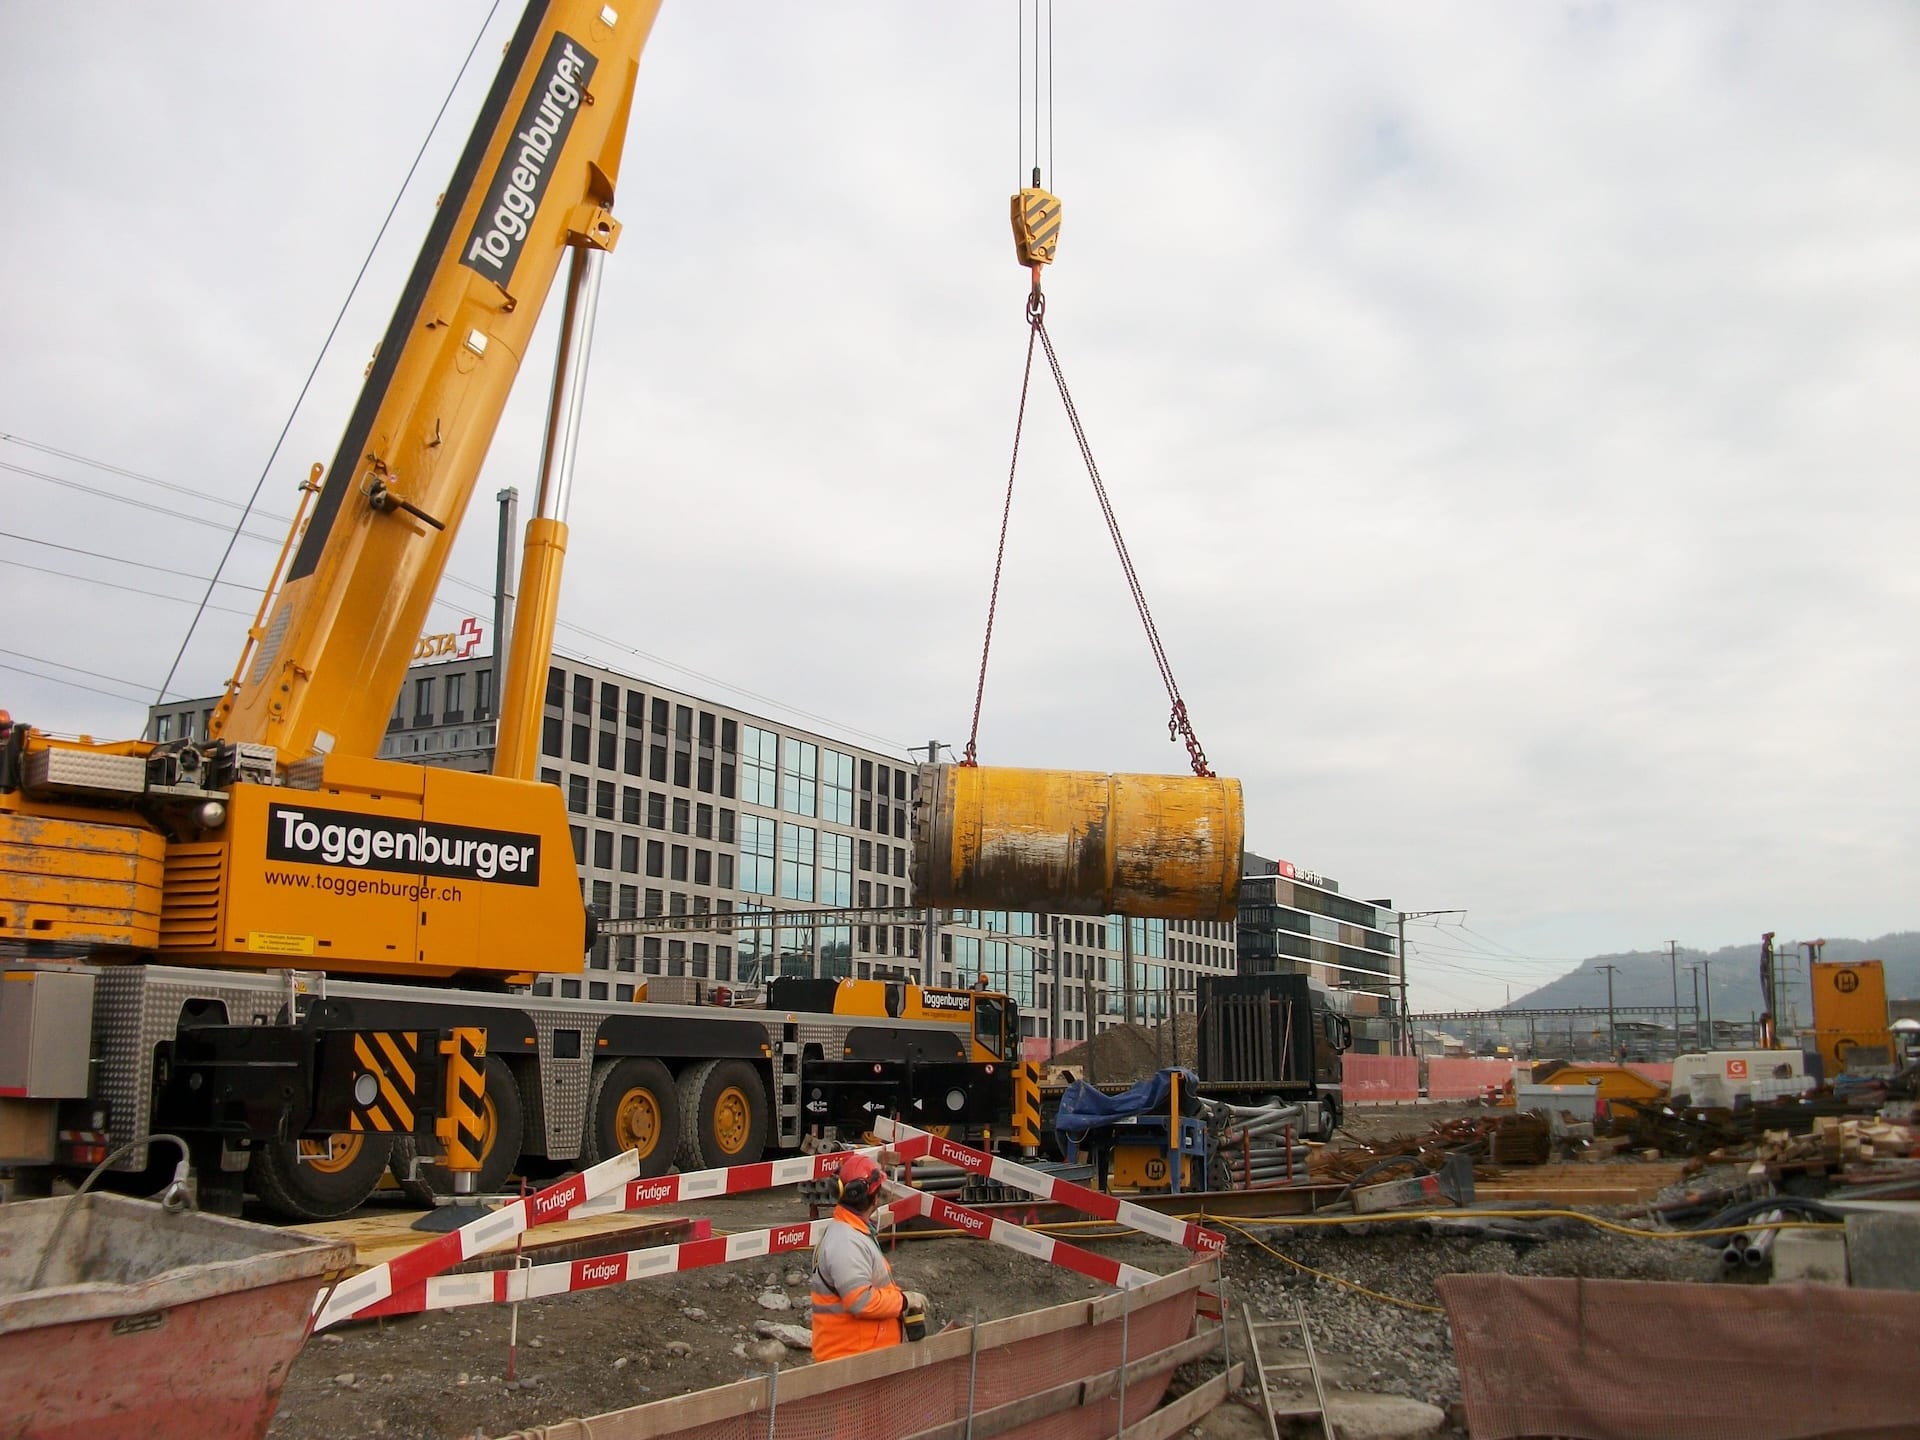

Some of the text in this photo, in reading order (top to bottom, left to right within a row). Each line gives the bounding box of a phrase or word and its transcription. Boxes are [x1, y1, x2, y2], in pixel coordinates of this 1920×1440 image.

[468, 42, 585, 270] Toggenburger
[276, 810, 534, 878] Toggenburger
[265, 869, 462, 902] www.toggenburger.ch
[923, 991, 970, 1010] Toggenburger
[821, 1157, 841, 1172] Fruti
[941, 1143, 983, 1168] Frutiger
[636, 1183, 671, 1201] Frutiger
[943, 1205, 984, 1230] Frutiger
[777, 1229, 805, 1246] Frutiger
[582, 1261, 620, 1281] Frutiger
